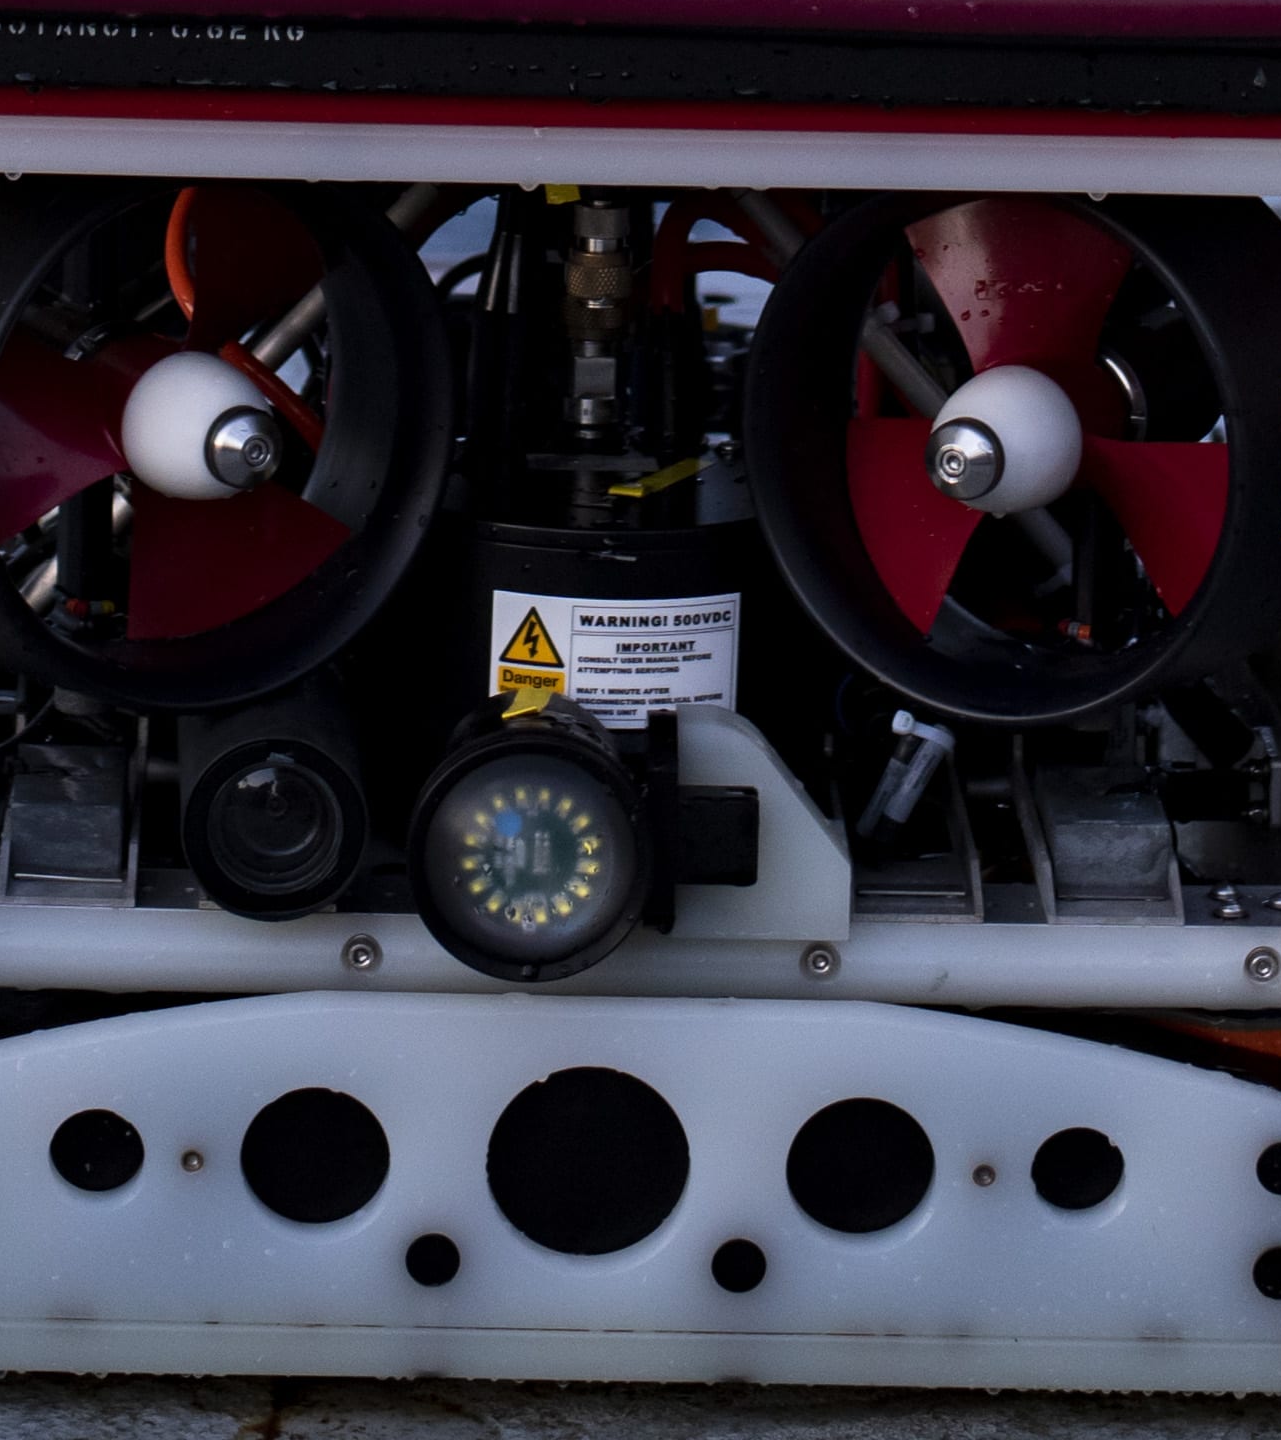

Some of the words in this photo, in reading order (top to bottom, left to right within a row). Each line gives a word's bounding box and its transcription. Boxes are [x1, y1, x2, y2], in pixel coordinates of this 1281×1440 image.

[579, 614, 668, 628] WARNING!
[673, 611, 732, 626] 500VDC
[616, 640, 697, 654] IMPORTANT
[577, 656, 618, 664] CONSULT
[620, 656, 643, 664] USER
[645, 655, 680, 663] MANUAL
[682, 653, 713, 662] BEFORE
[577, 666, 633, 675] ATTEMPTING
[635, 666, 680, 674] SERVICING
[502, 669, 559, 689] Danger
[576, 687, 598, 695] WAIT
[600, 687, 605, 695] 1
[608, 687, 642, 695] MINUTE
[643, 687, 670, 695] AFTER
[649, 696, 692, 705] UMBILICAL
